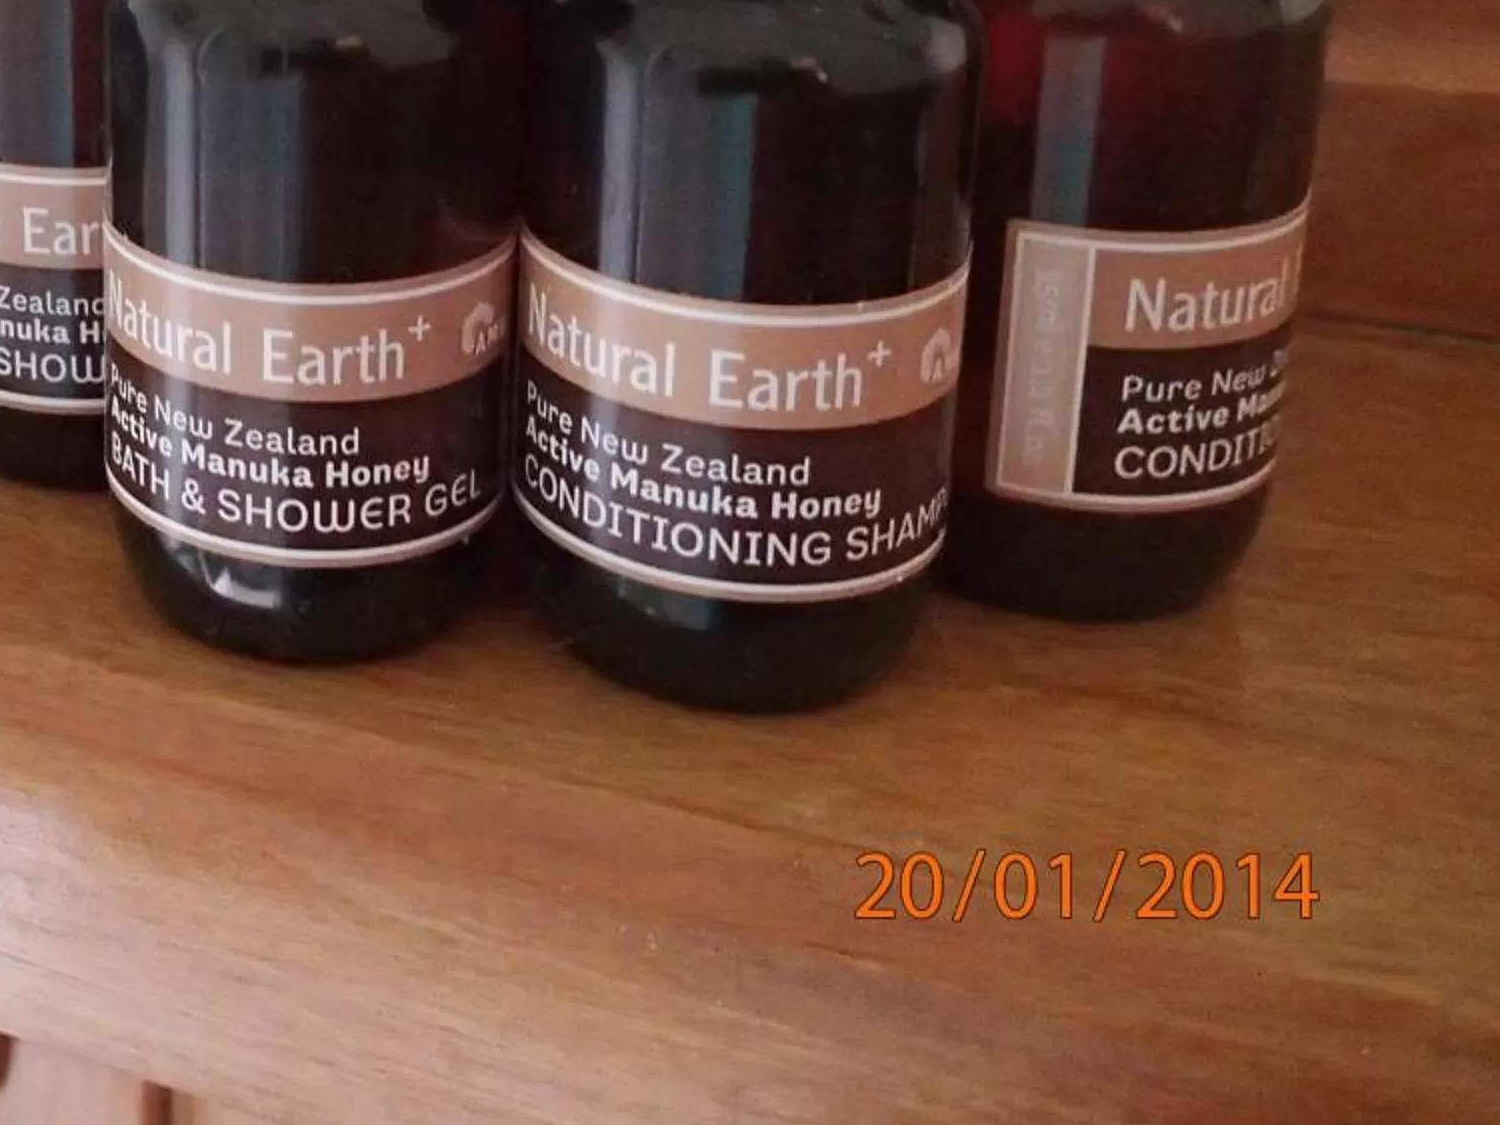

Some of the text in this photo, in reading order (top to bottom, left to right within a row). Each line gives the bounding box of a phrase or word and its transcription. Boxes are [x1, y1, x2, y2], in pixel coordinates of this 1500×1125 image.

[22, 206, 99, 256] Ear
[108, 267, 231, 375] Natural
[528, 281, 676, 399] Natural
[1125, 255, 1289, 332] Natural
[110, 362, 360, 457] Pure New Zealand
[526, 379, 811, 486] Pure New Zealand
[1116, 403, 1230, 436] Active
[1120, 373, 1203, 404] Pure
[1210, 364, 1268, 397] New
[110, 394, 431, 489] Active Manuka Honey
[110, 432, 482, 535] BATH & SHOWER GEL
[525, 414, 884, 521] Active Manuka Honey
[524, 453, 948, 568] CONDITIONING SHAMP
